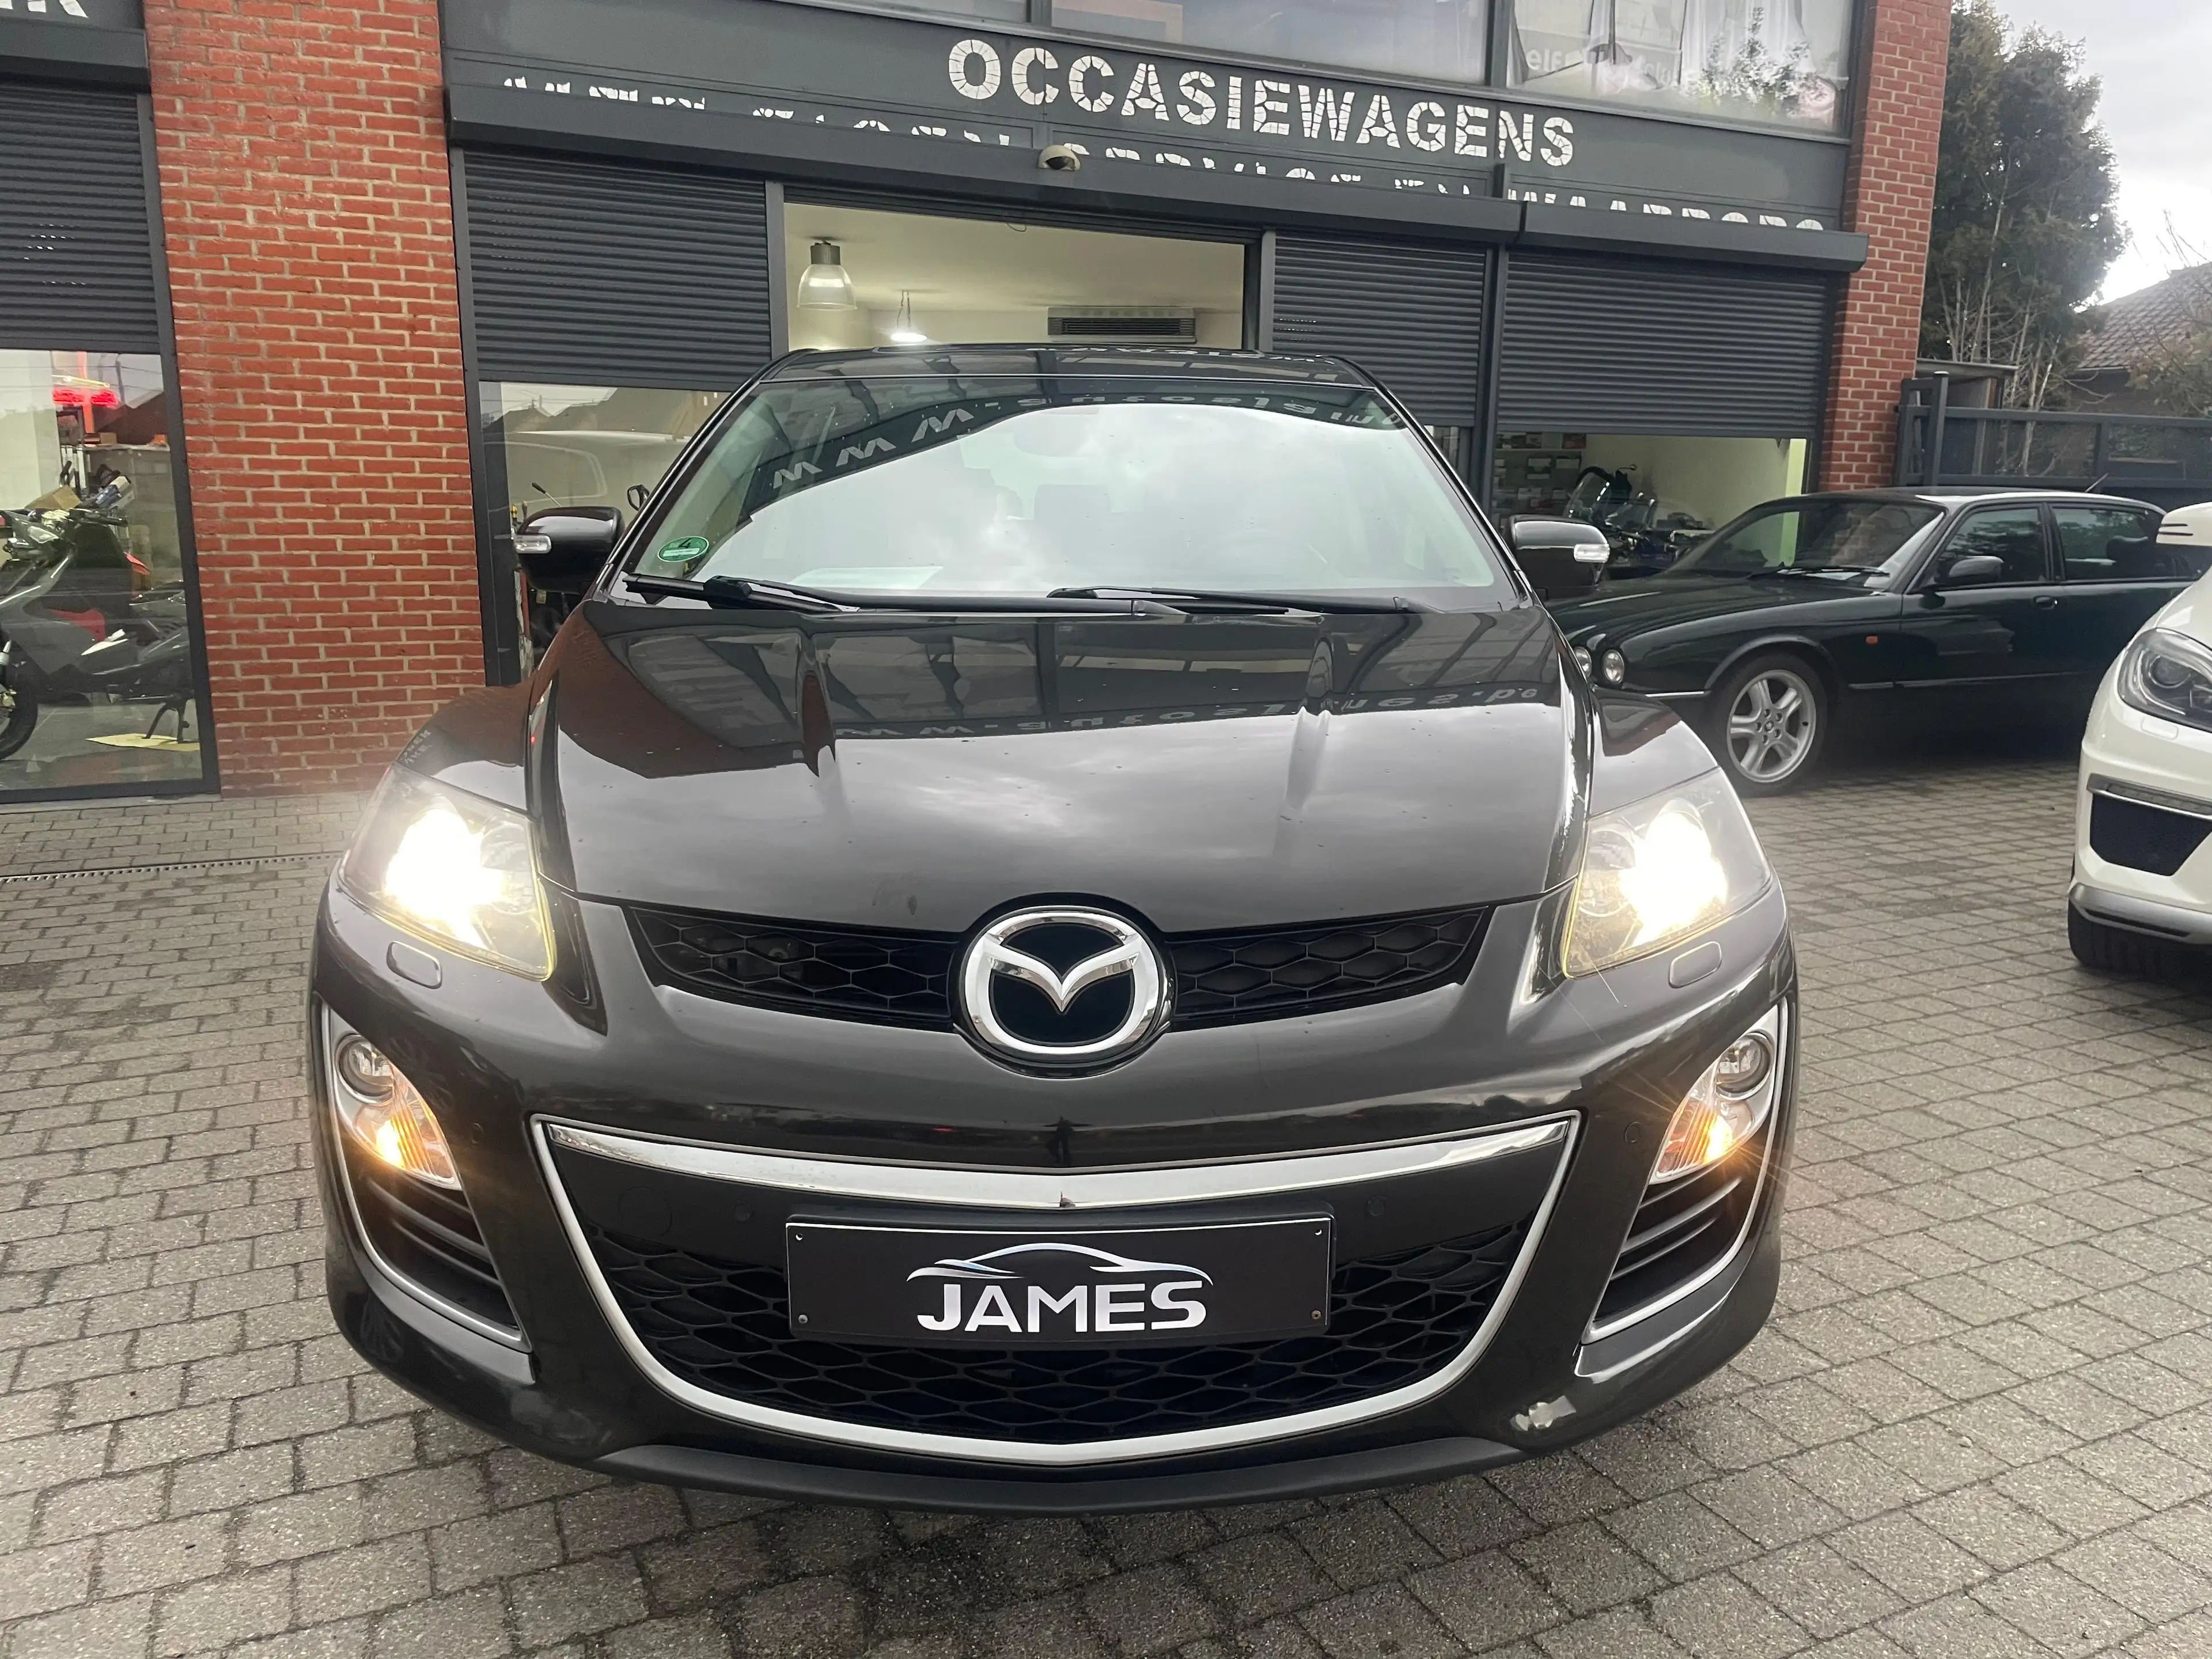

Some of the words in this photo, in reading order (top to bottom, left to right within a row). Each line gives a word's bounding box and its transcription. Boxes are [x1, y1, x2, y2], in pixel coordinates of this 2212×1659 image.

[948, 39, 1574, 166] OCCASIEWAGENS
[677, 538, 692, 549] 4
[918, 1280, 1206, 1333] JAMES
